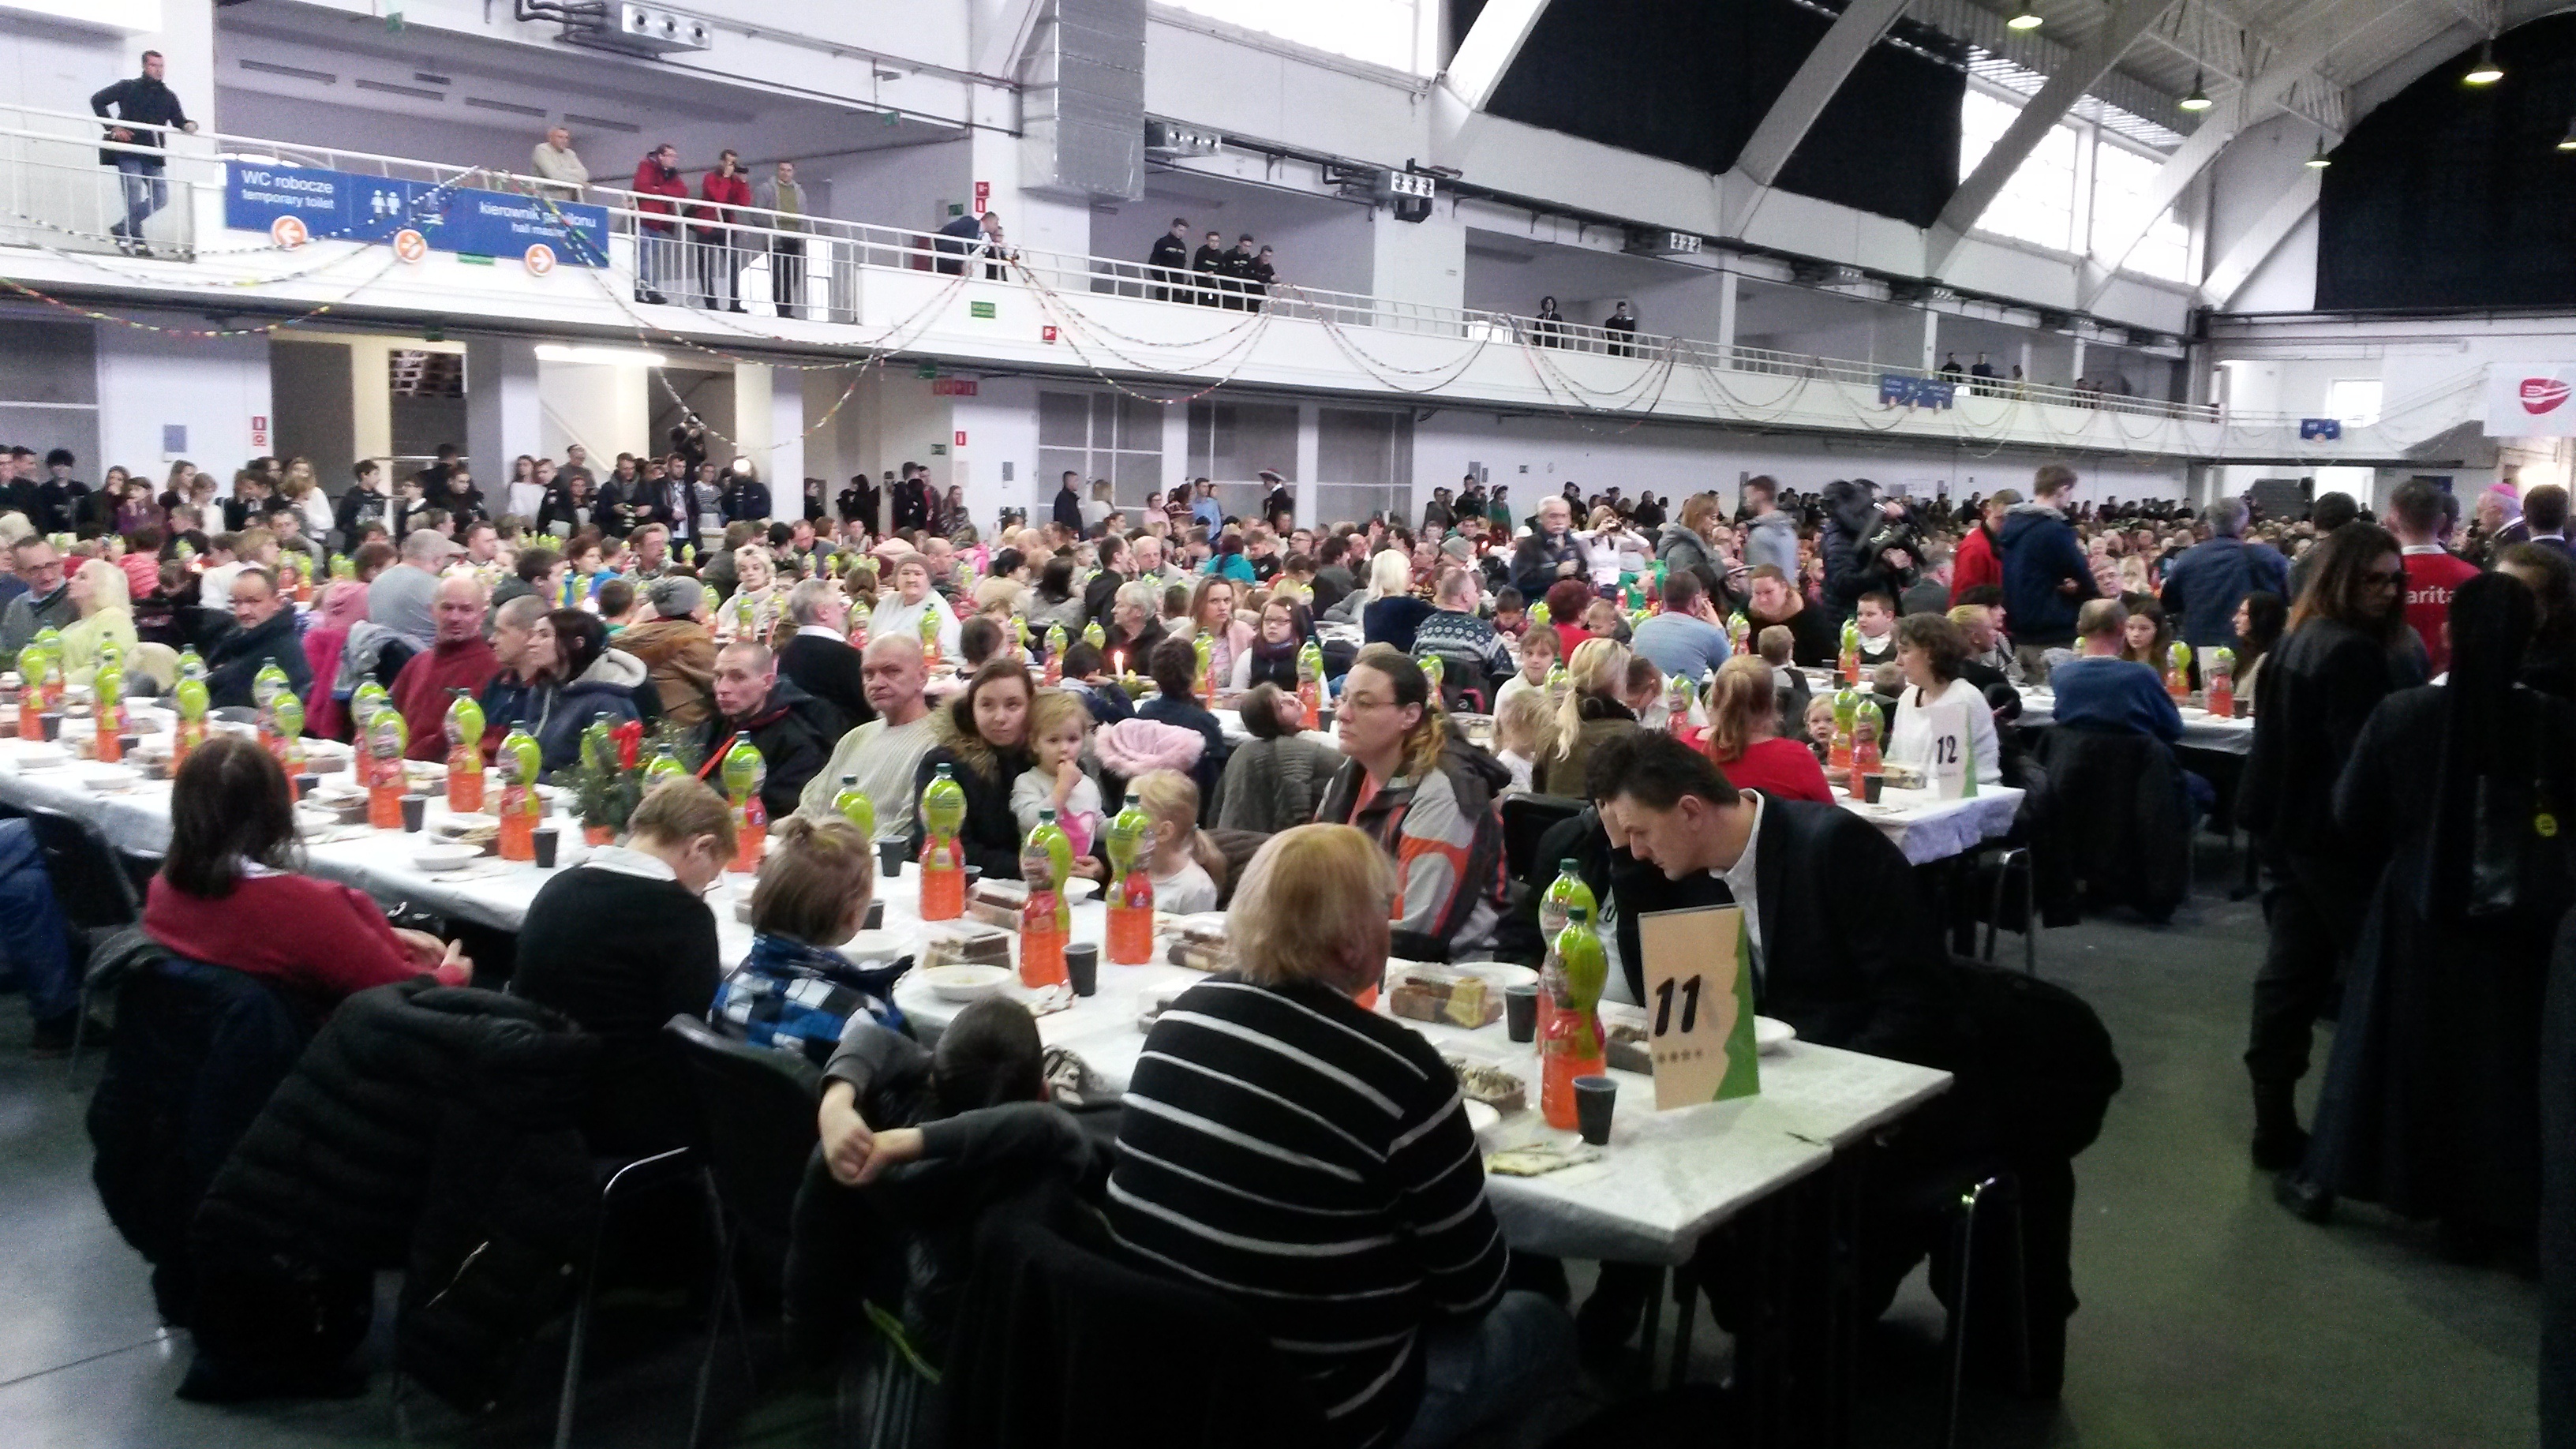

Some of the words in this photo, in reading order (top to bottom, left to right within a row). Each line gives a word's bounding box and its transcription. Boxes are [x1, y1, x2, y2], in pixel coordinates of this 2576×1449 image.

[241, 170, 271, 186] WC
[275, 175, 334, 194] robocze
[242, 189, 304, 208] temporary
[305, 197, 335, 209] toilet
[478, 200, 540, 220] kierownik
[2406, 586, 2456, 605] arita
[1937, 734, 1958, 765] 12
[1654, 974, 1702, 1038] 11
